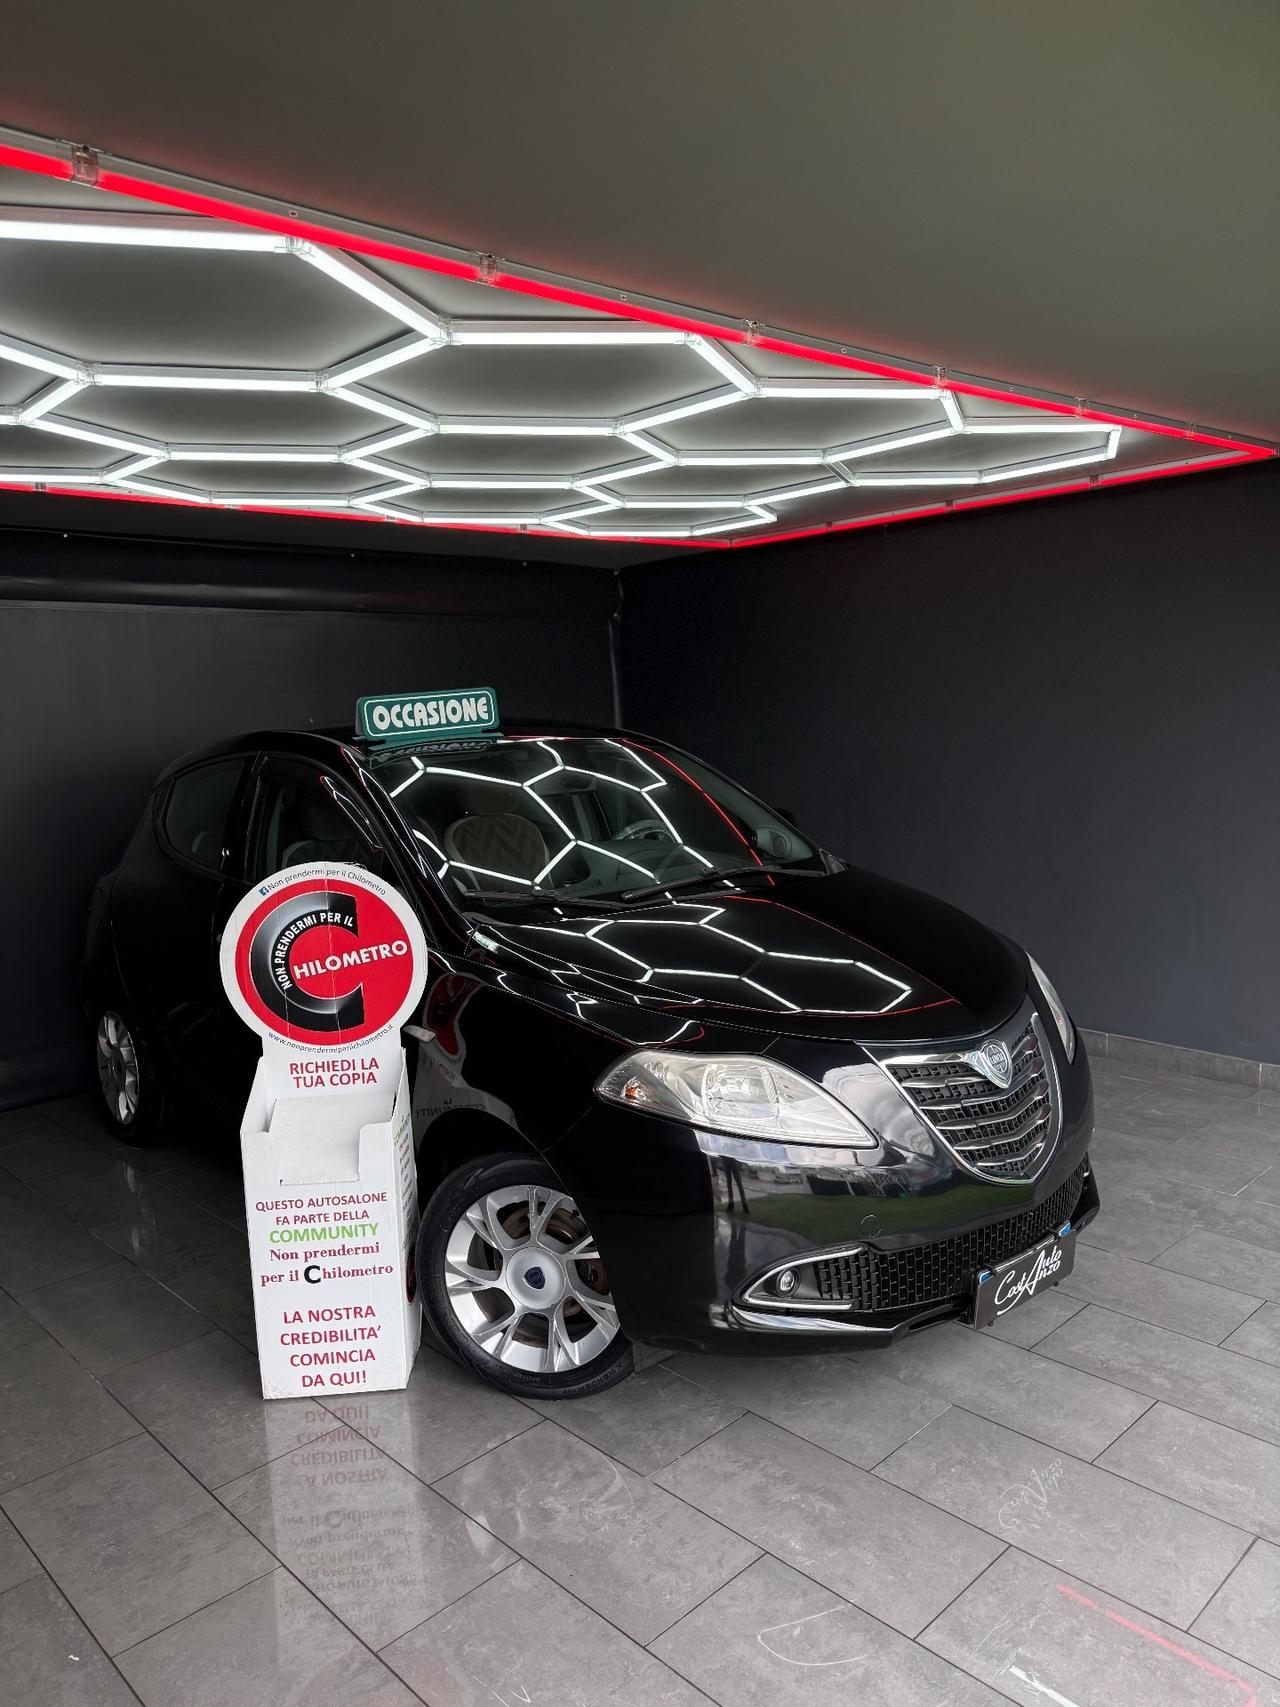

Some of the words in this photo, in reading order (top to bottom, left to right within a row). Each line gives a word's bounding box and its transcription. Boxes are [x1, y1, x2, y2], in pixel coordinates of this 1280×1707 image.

[372, 696, 489, 731] OCCASIONE
[268, 879, 284, 891] Non
[284, 869, 325, 884] prendermi
[341, 868, 347, 877] il
[347, 871, 386, 896] Chilometro
[319, 912, 341, 923] PER
[343, 915, 354, 927] IL
[274, 914, 317, 964] PRENDERMI
[275, 967, 293, 990] NON
[289, 1059, 356, 1075] RICHIEDI
[361, 1057, 379, 1070] LA
[293, 1075, 326, 1089] TUA
[329, 1072, 378, 1087] COPIA
[255, 1198, 304, 1213] QUESTO
[307, 1192, 388, 1209] AUTOSALONE
[275, 1216, 291, 1226] FA
[293, 1213, 330, 1225] PARTE
[333, 1209, 370, 1222] DELLA
[269, 1222, 379, 1244] COMMUNITY
[270, 1248, 300, 1261] Non
[303, 1242, 380, 1263] prendermi
[260, 1273, 285, 1287] per
[289, 1270, 299, 1282] il
[303, 1264, 394, 1285] Chilometro
[283, 1310, 303, 1324] LA
[308, 1305, 376, 1323] NOSTRA
[280, 1325, 382, 1346] CREDIBILITA'
[290, 1348, 376, 1367] COMINCIA
[302, 1374, 325, 1388] DA
[330, 1370, 367, 1386] QUI!
